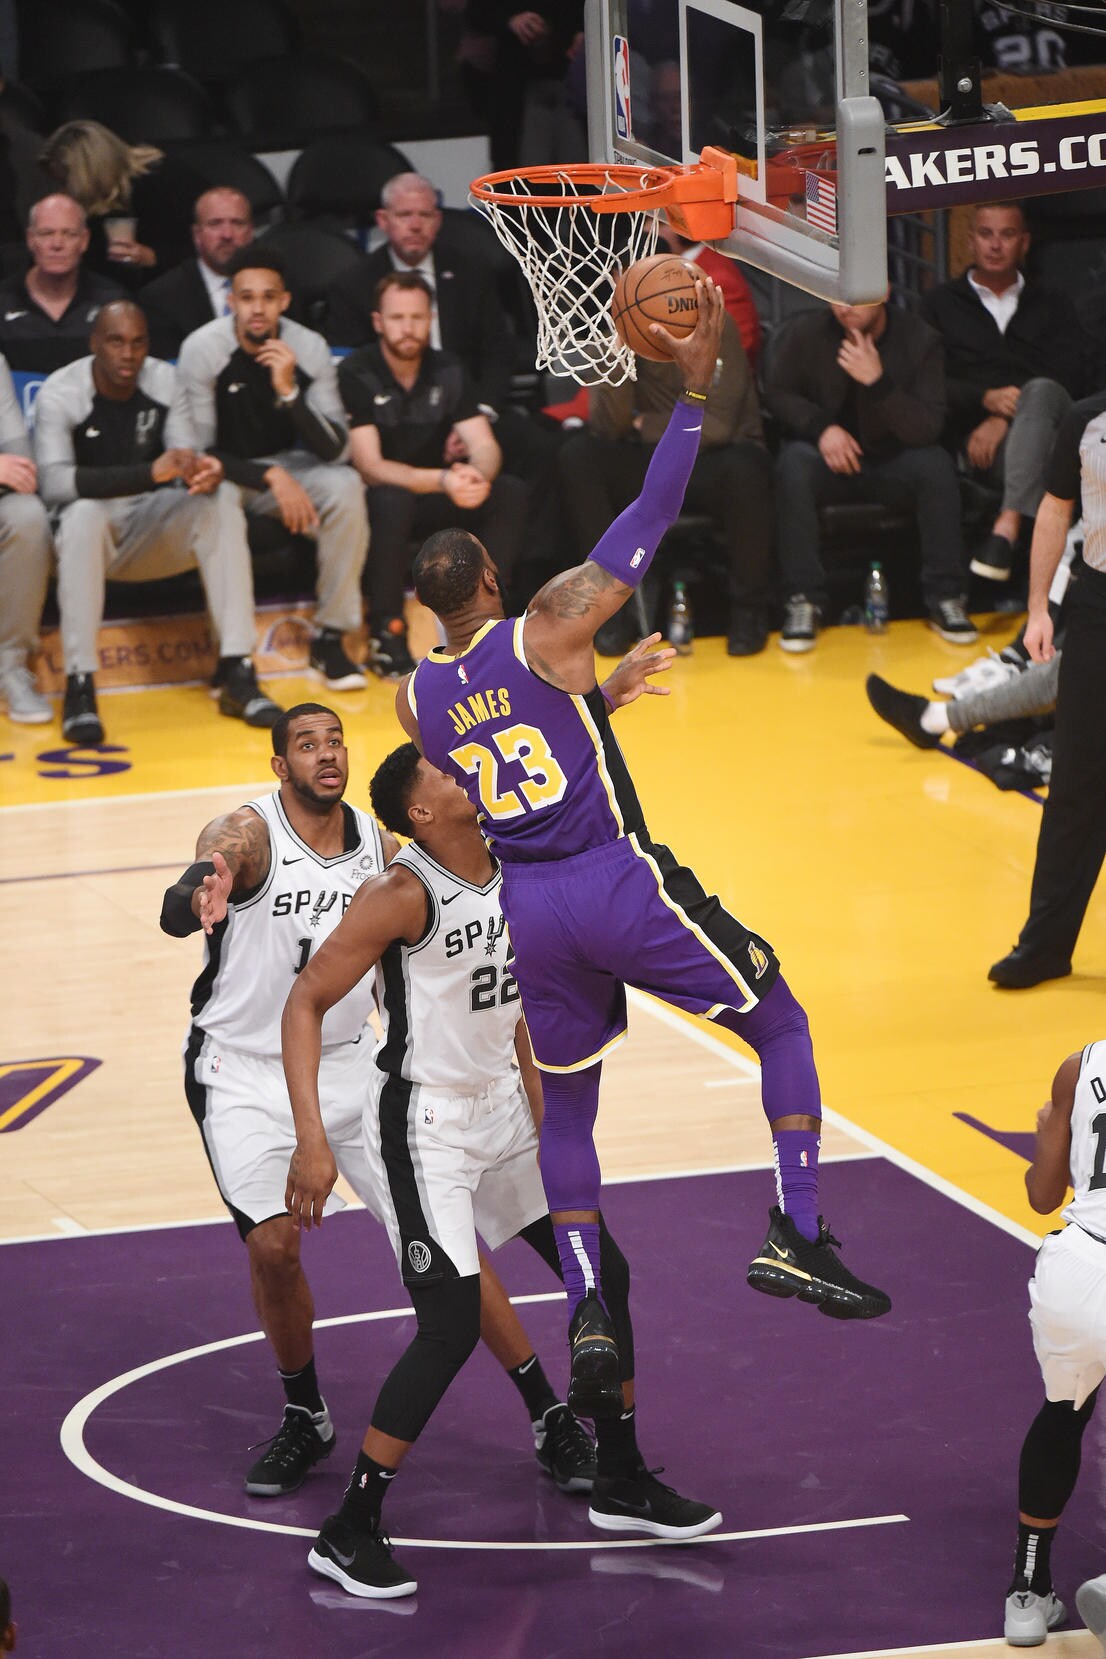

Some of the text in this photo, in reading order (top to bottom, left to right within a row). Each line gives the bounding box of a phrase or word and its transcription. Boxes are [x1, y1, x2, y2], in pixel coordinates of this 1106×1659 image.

[447, 688, 511, 735] JAMES
[448, 723, 568, 820] 23
[469, 963, 521, 1013] 22
